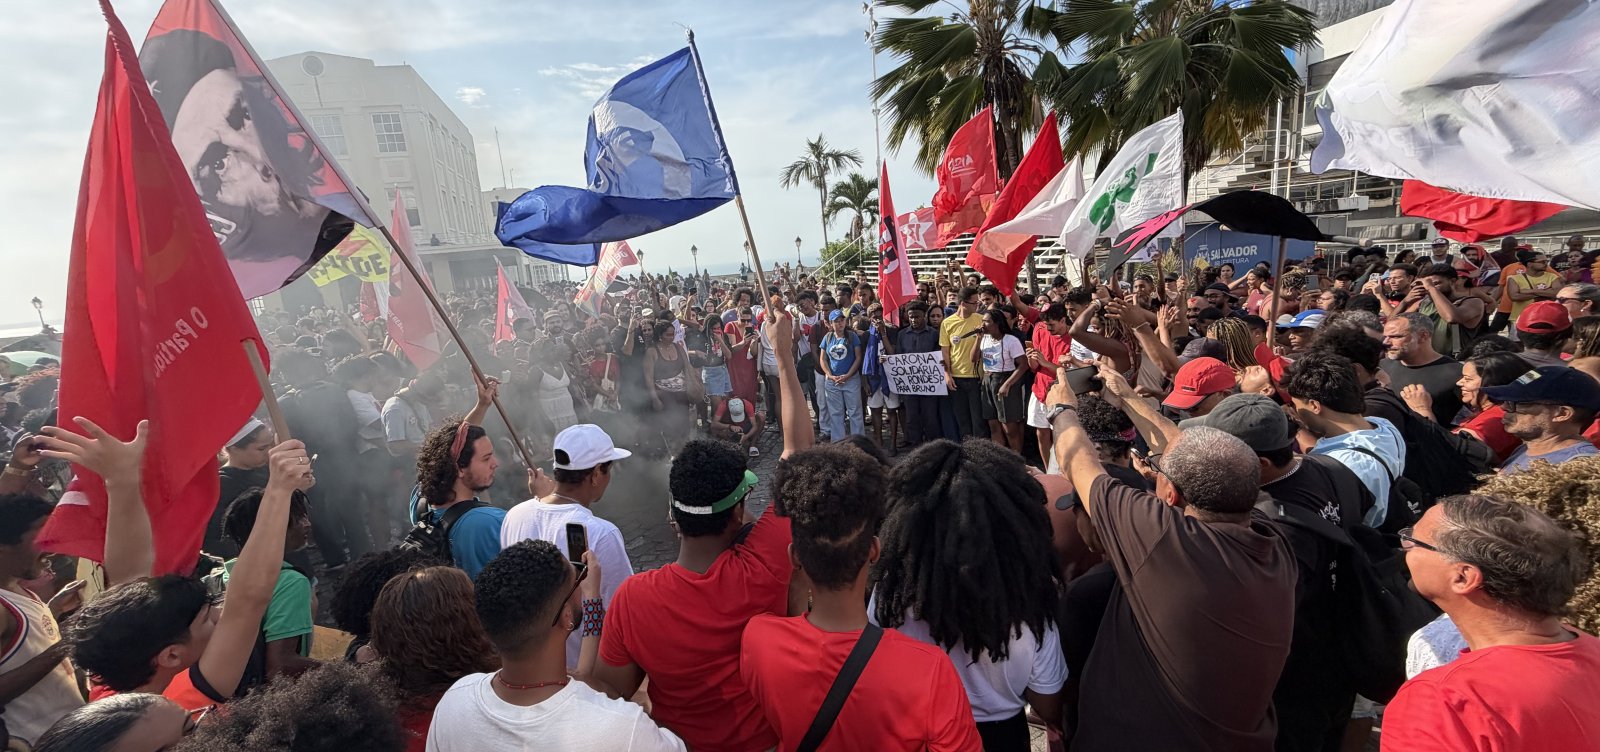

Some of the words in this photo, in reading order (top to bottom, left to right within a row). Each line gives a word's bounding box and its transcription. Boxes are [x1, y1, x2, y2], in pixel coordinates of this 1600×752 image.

[1210, 245, 1258, 261] SALVADOR
[887, 354, 937, 366] CARONA
[891, 362, 941, 376] SOLIDÁRIA
[893, 377, 906, 386] DA
[907, 375, 945, 385] RONDESP
[896, 385, 912, 393] PARA
[911, 385, 936, 393] BRUNO
